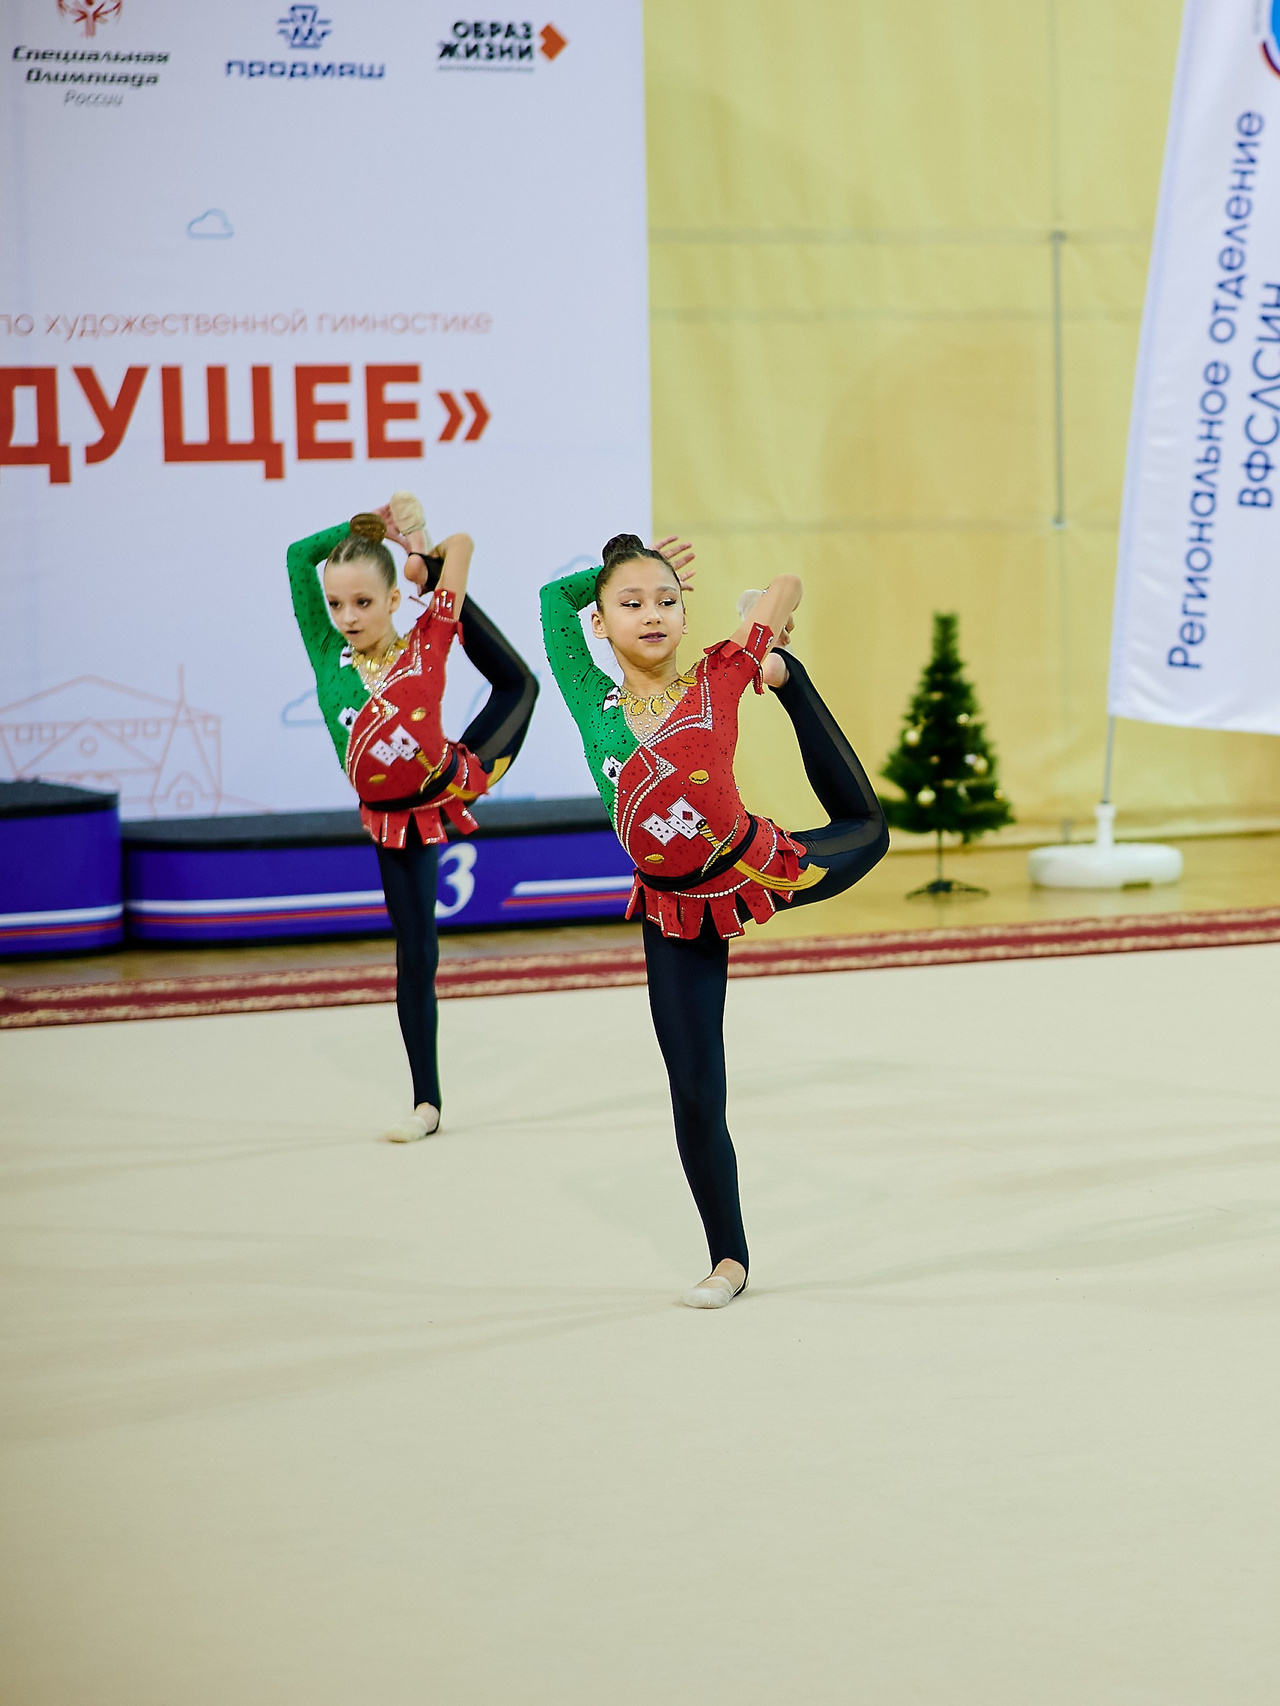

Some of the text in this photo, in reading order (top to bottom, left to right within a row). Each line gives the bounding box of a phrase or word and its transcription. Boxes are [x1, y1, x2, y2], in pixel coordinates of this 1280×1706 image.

[453, 21, 531, 39] ОБРАЗ
[12, 45, 171, 64] Специальная
[439, 43, 533, 59] ЖИЗНИ
[26, 67, 159, 88] Олимпиада
[64, 90, 125, 106] России
[0, 309, 492, 341] по художественной гимнастике
[1167, 111, 1264, 669] Региональное отделение
[434, 843, 477, 918] 3
